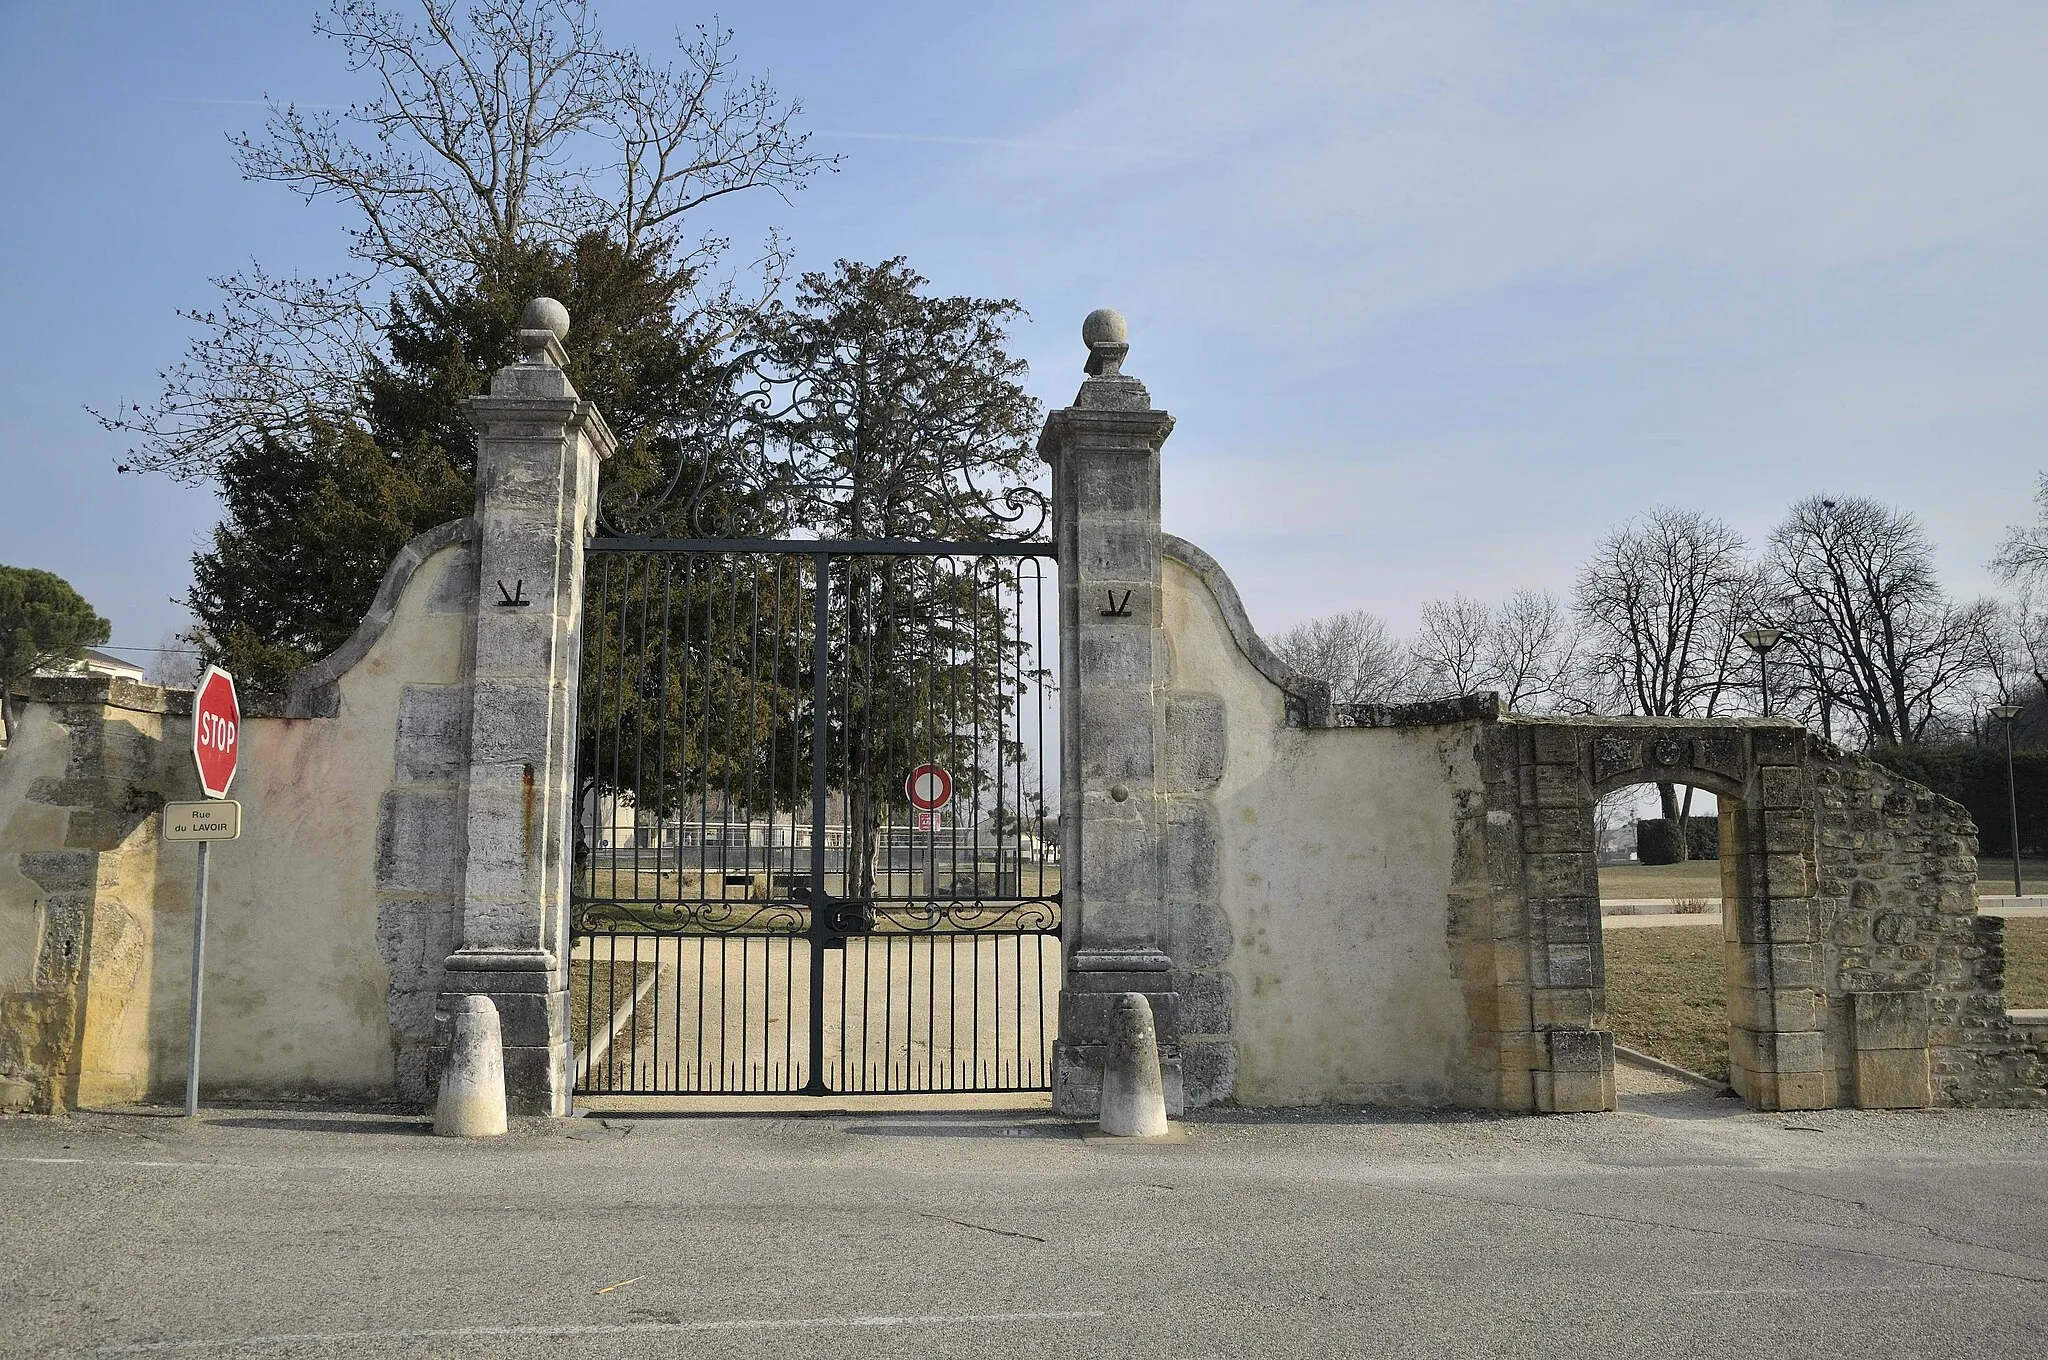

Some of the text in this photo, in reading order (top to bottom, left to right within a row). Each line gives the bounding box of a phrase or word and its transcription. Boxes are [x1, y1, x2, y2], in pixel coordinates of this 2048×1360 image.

[201, 710, 235, 754] STOP
[192, 811, 211, 819] Rue
[193, 823, 227, 832] LAVOIR
